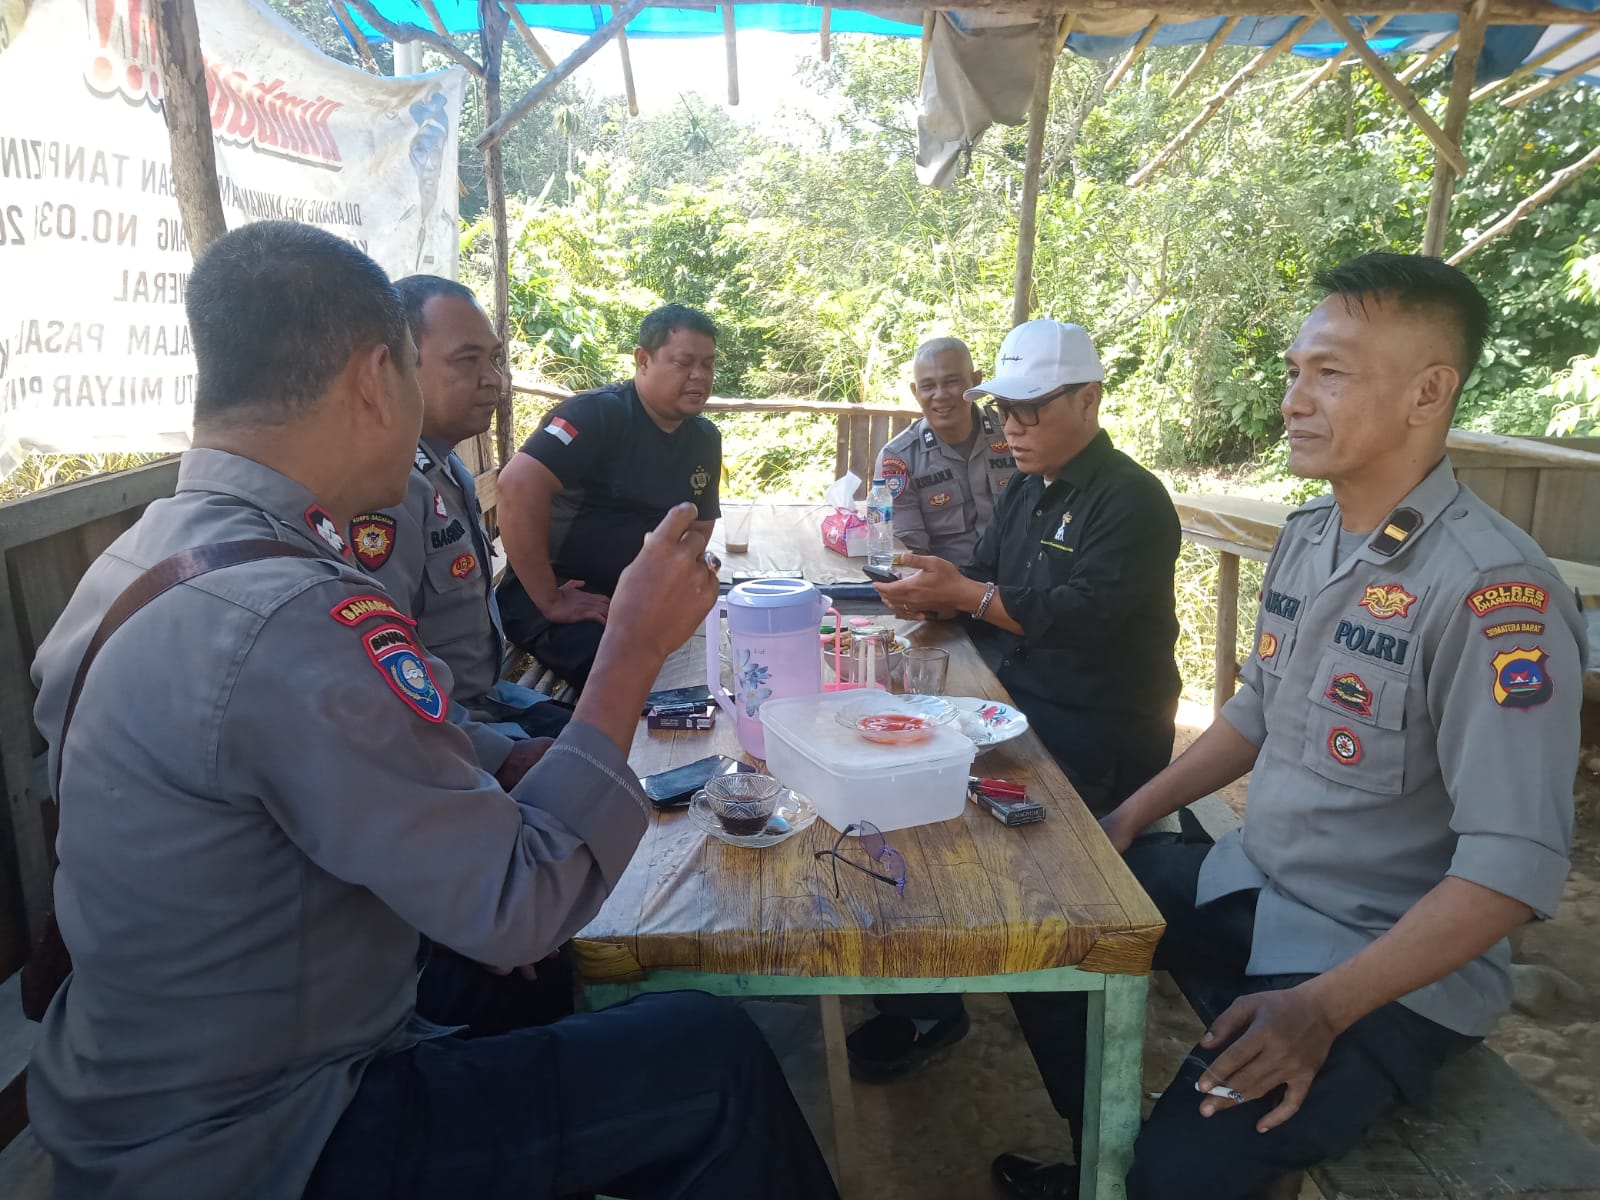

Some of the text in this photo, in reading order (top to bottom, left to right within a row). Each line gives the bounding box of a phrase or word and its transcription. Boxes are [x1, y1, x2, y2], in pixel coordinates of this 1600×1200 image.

[1472, 586, 1545, 607] POLRES
[1478, 595, 1543, 612] DHARMASRAYA
[1486, 623, 1542, 638] SUMATERA BARAT
[1333, 619, 1409, 665] POLRI
